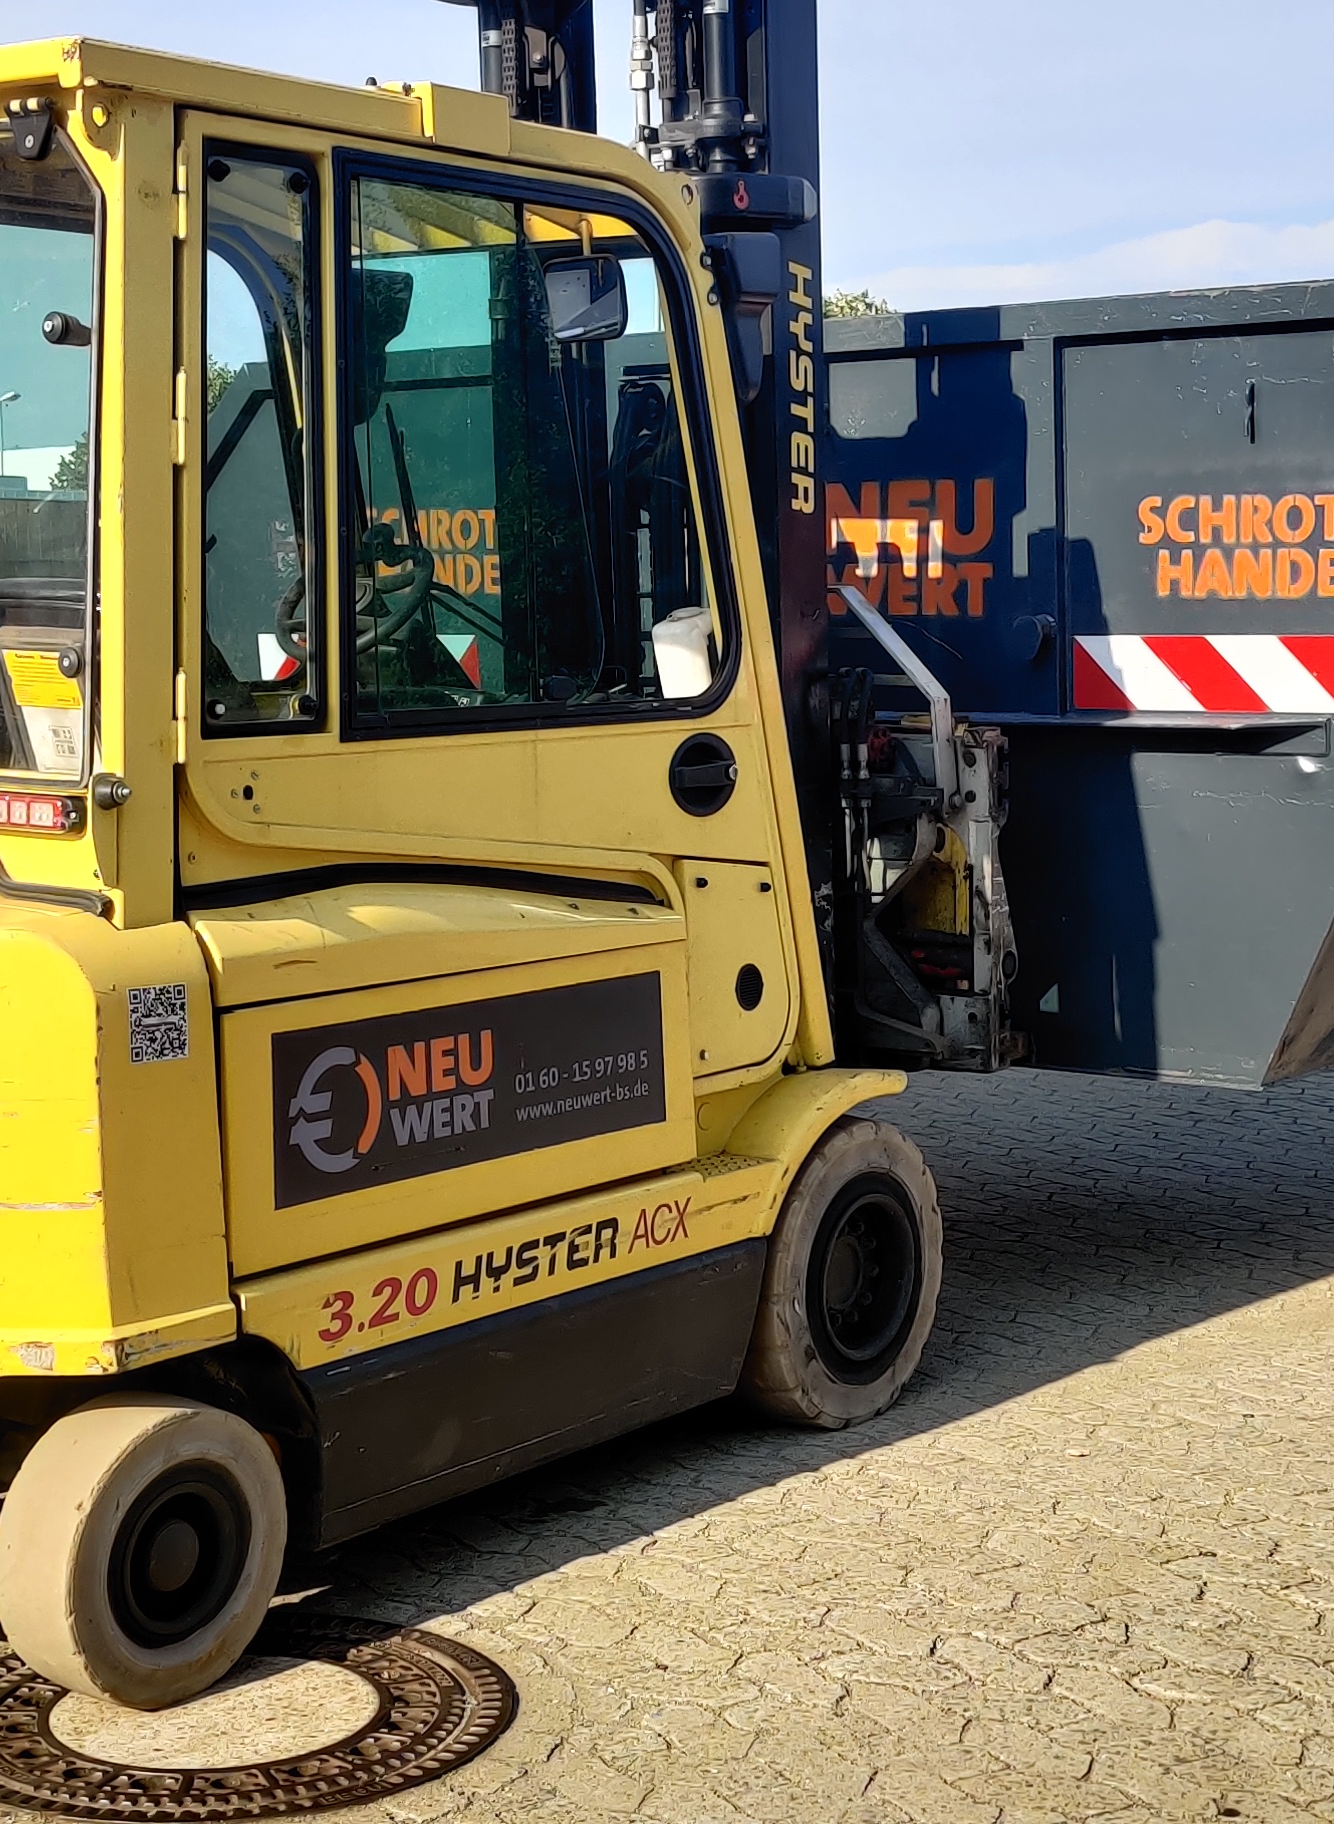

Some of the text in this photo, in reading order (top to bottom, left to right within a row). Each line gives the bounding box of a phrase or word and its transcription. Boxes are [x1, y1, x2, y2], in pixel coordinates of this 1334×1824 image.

[787, 260, 815, 515] HYSTER
[825, 477, 995, 556] NEU
[387, 1029, 495, 1101] NEU
[515, 1071, 535, 1094] 01
[539, 1067, 559, 1089] 60
[572, 1060, 591, 1082] 15
[595, 1056, 613, 1078] 97
[617, 1052, 635, 1073] 98
[640, 1050, 648, 1069] 5
[516, 1079, 649, 1121] www.neuwert-bs.de
[390, 1090, 495, 1147] WERT
[318, 1197, 692, 1342] 3.20 HYSTER ACX
